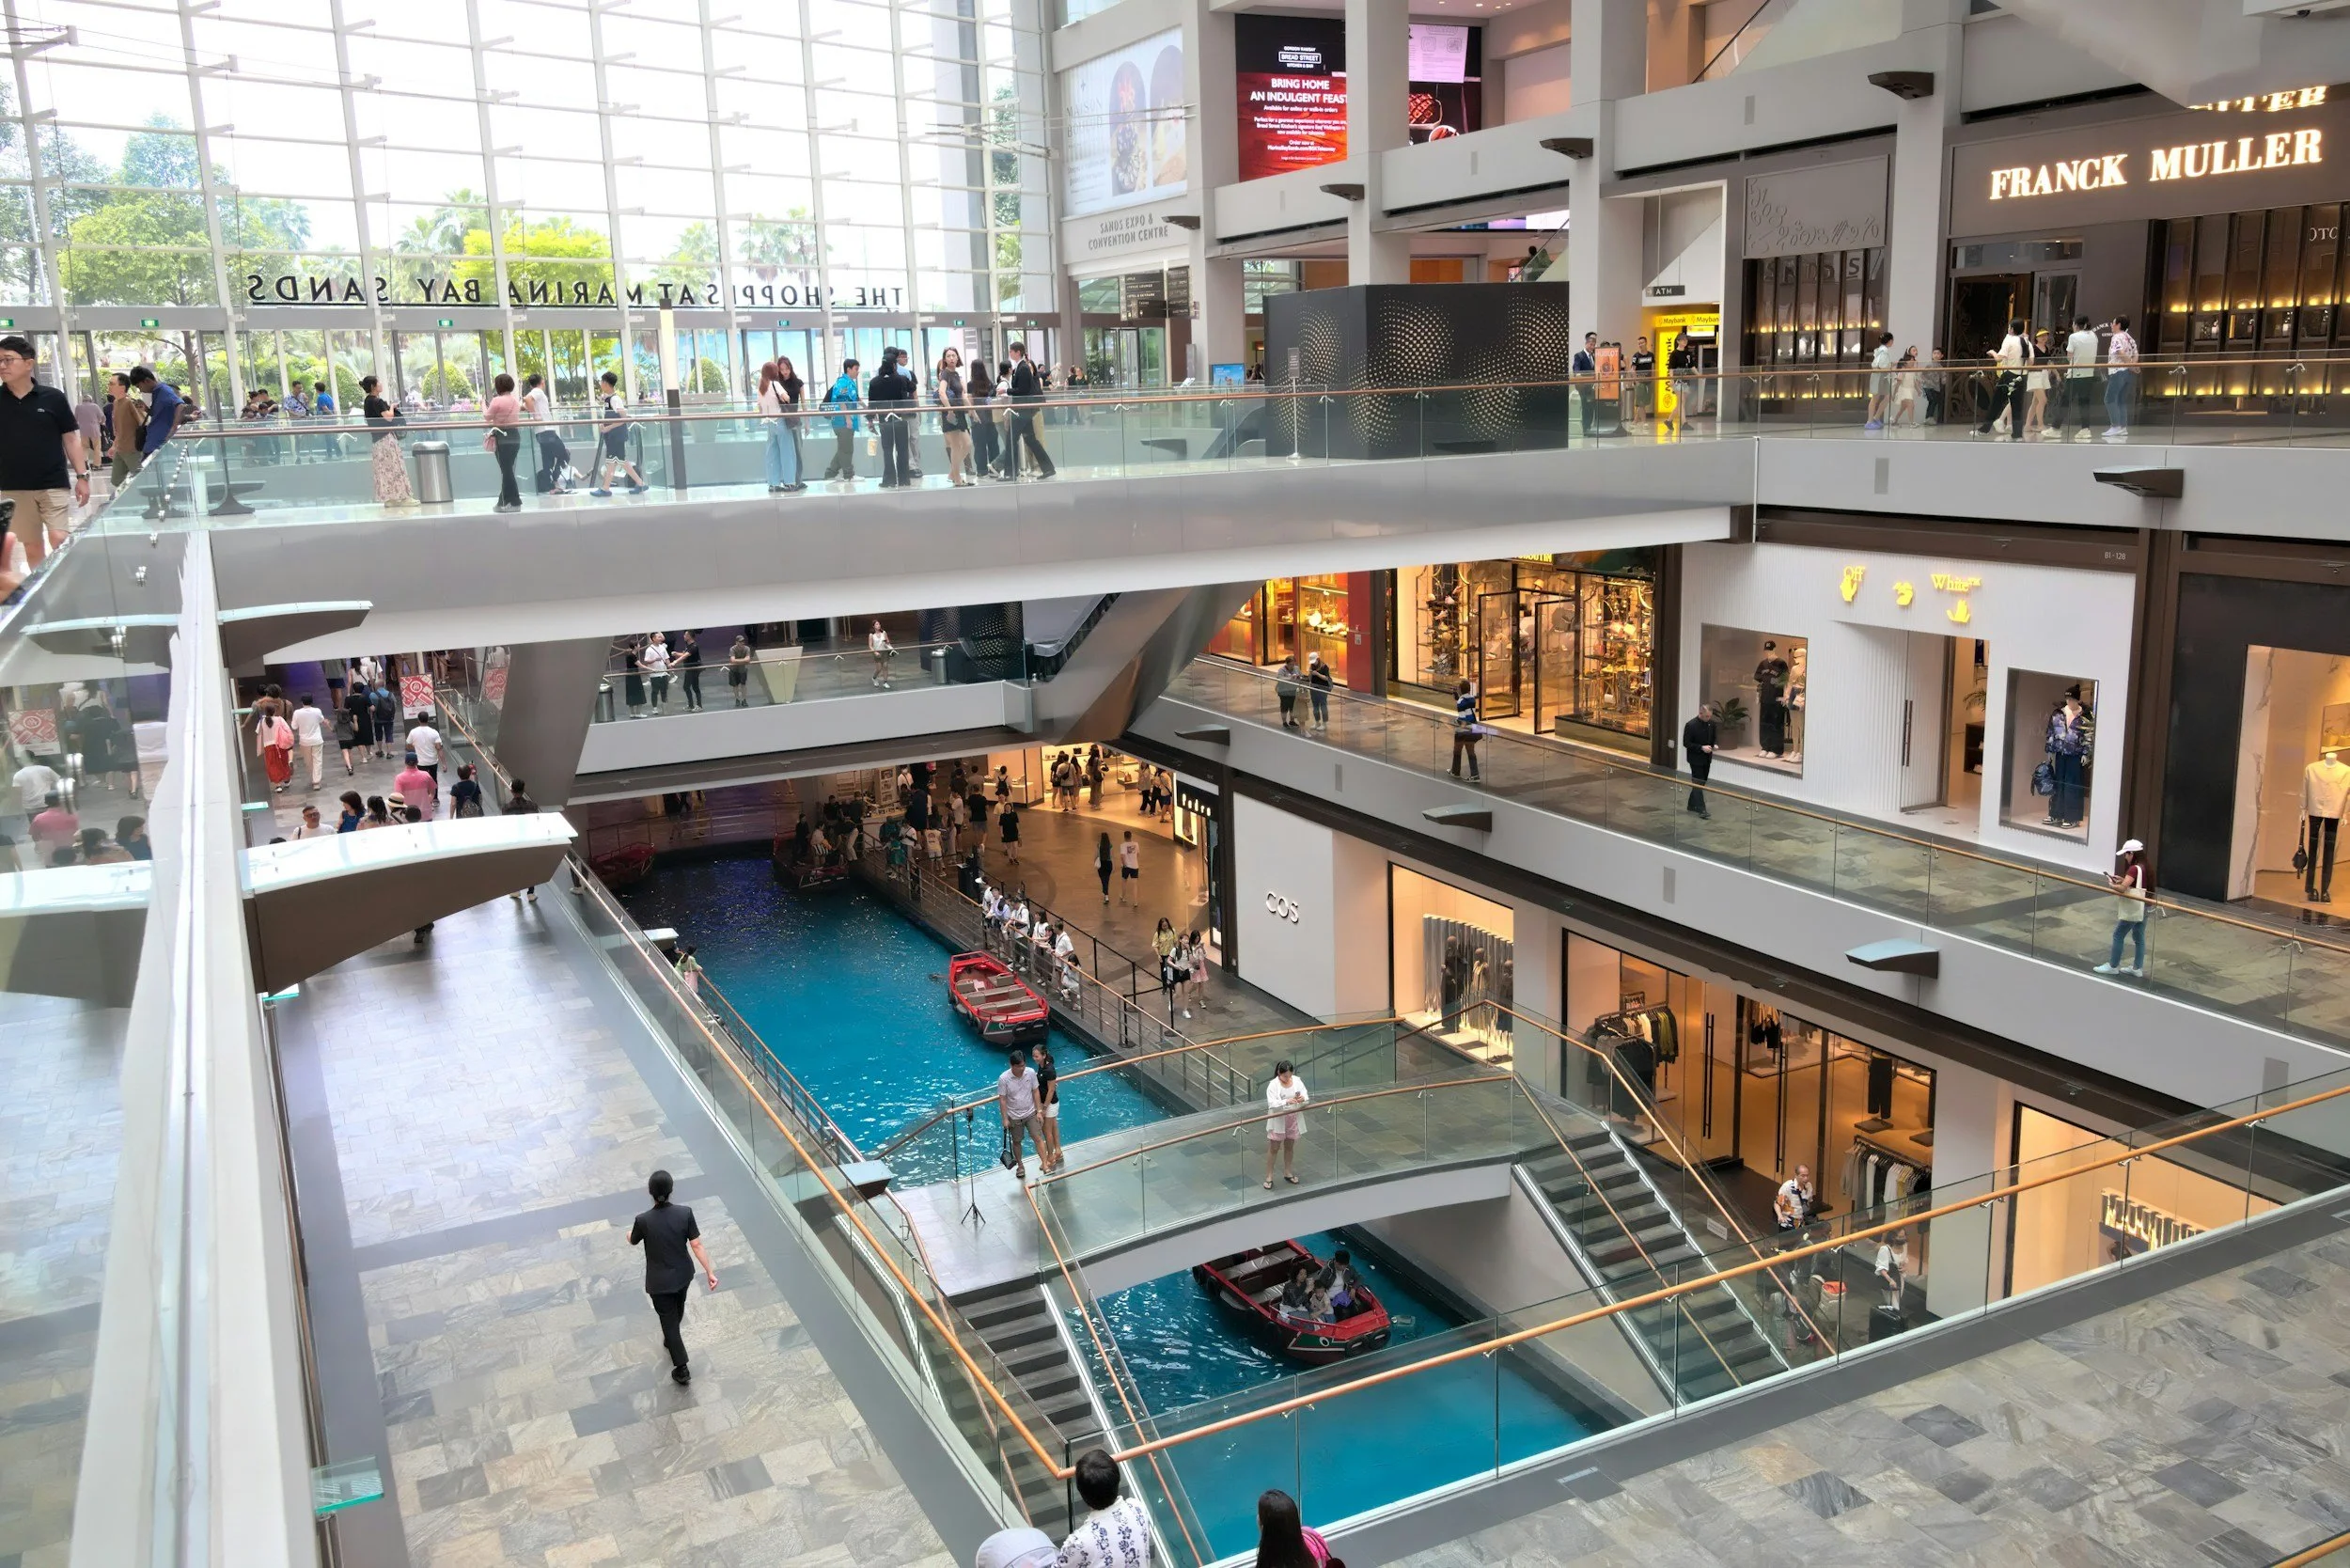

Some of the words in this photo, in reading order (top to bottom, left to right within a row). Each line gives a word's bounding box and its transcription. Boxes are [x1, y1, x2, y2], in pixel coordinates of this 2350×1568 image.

[1271, 78, 1300, 88] BRING
[1302, 79, 1329, 89] HOME
[1250, 91, 1265, 101] AN
[1267, 92, 1321, 102] INDULGENT
[1323, 93, 1347, 103] FEAST
[1989, 153, 2128, 200] FRANCK
[2149, 128, 2324, 182] MULLER
[1100, 220, 1123, 234] SANDS
[1125, 215, 1145, 229] EXPO
[1088, 231, 1136, 250] CONVENTION
[1138, 226, 1168, 242] CENTRE
[1664, 317, 1686, 325] Maybank
[1844, 565, 1866, 582] Off
[1265, 891, 1299, 924] COS
